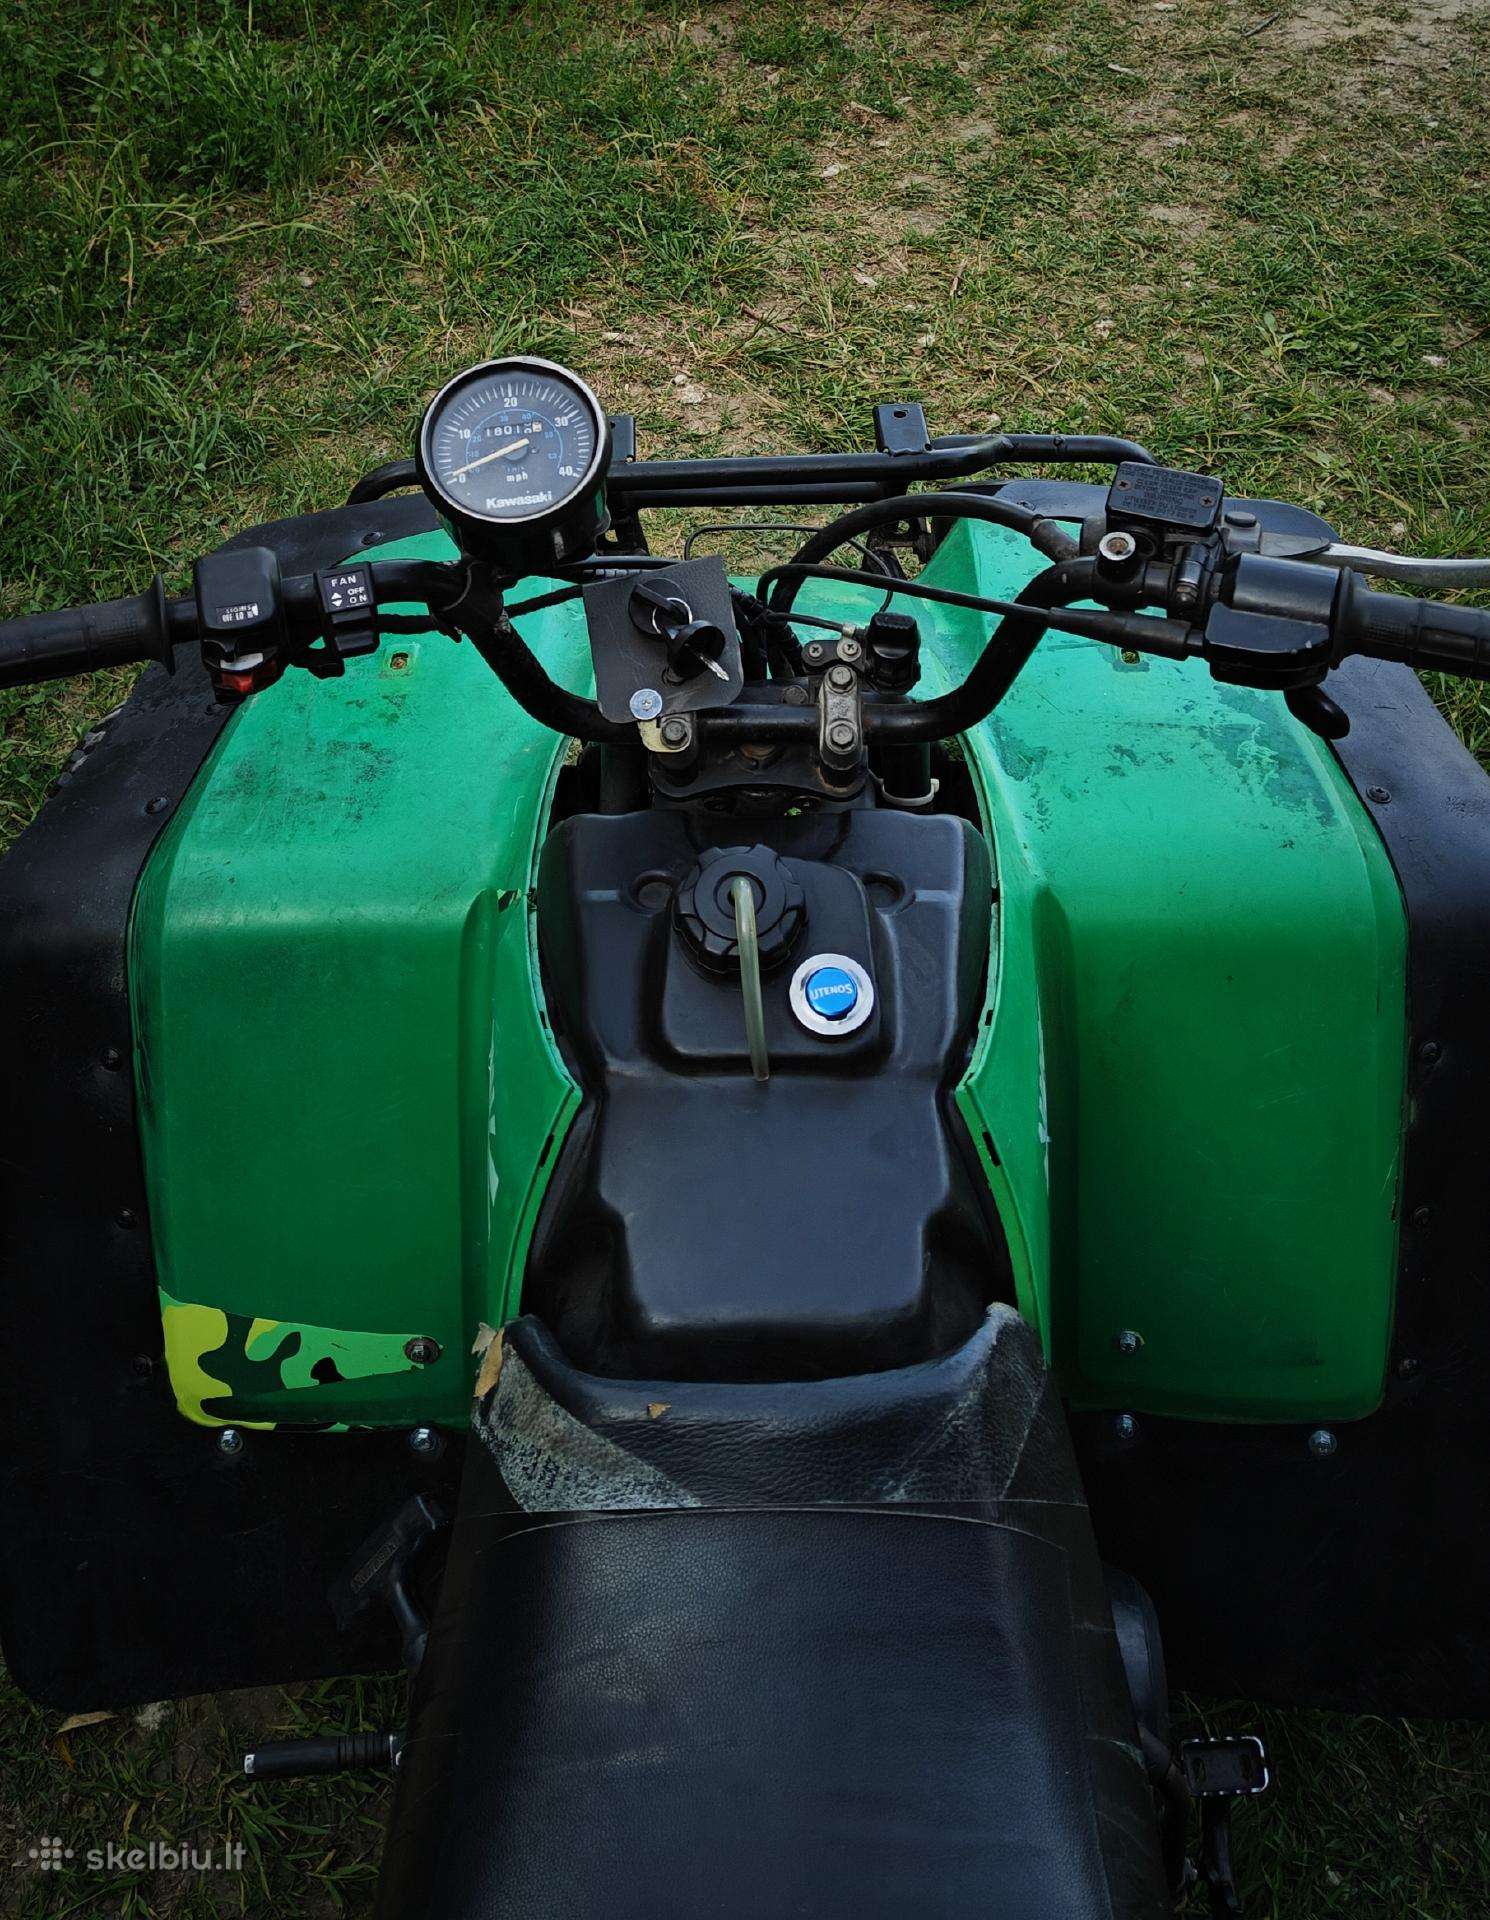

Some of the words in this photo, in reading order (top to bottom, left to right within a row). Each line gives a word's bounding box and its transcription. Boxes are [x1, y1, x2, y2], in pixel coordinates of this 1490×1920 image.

[503, 397, 518, 408] 20
[554, 416, 569, 428] 30
[459, 428, 471, 439] 10
[506, 471, 528, 482] mph
[559, 466, 573, 477] 40
[458, 473, 466, 483] 0
[486, 491, 552, 509] Kawasaki
[331, 575, 357, 587] FAN
[347, 586, 365, 596] OFF
[349, 594, 367, 604] ON
[810, 983, 853, 1000] UTENOS
